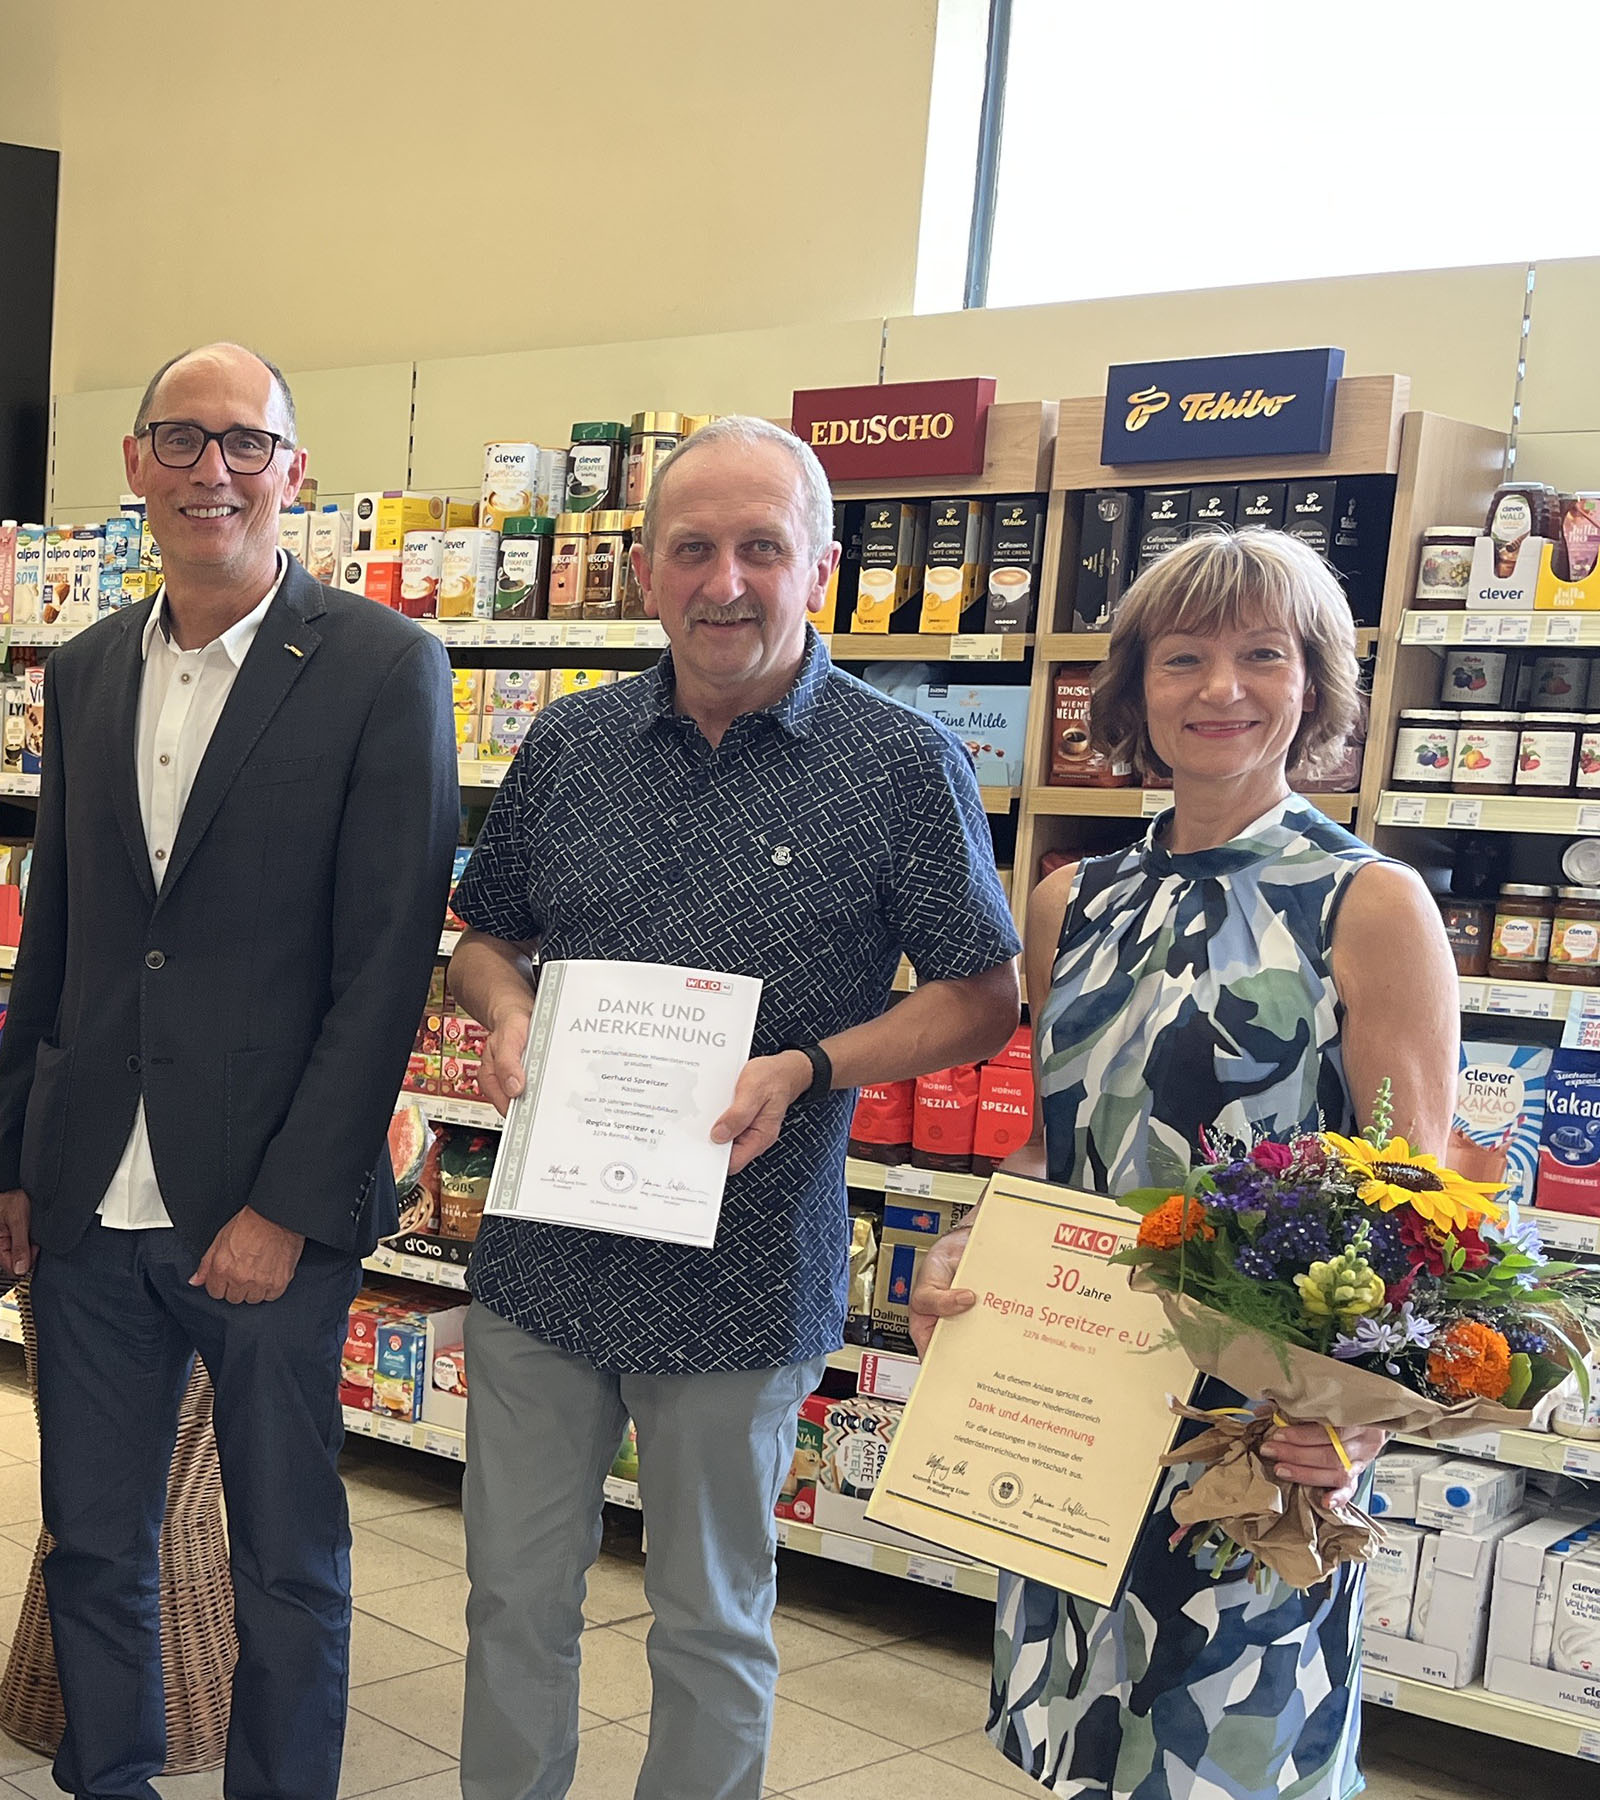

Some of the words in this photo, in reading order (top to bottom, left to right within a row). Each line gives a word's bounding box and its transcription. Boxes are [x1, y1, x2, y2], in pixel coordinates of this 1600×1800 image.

[1179, 390, 1297, 422] Tchibo
[810, 413, 954, 446] EDUSCHO
[495, 454, 525, 464] clever
[579, 456, 601, 464] clever
[1152, 510, 1178, 520] Tchibo
[1198, 508, 1225, 518] Tchibo
[1245, 506, 1273, 516] Tchibo
[1295, 502, 1324, 513] Tchibo
[936, 518, 960, 526] Tchibo
[1002, 518, 1027, 526] Tchibo
[1500, 512, 1526, 521] WALD
[870, 521, 893, 529] Tchibo
[17, 548, 40, 562] alpro
[47, 547, 70, 562] alpro
[73, 546, 96, 561] alpro
[508, 550, 529, 559] clever
[589, 563, 609, 571] GOLD
[16, 572, 38, 585] SOYA
[46, 573, 69, 583] MANDEL
[1479, 587, 1524, 600] clever
[10, 703, 25, 716] LY!
[932, 711, 965, 729] Feine
[968, 713, 1007, 729] Milde
[1506, 924, 1529, 932] clever
[1569, 928, 1593, 936] clever
[686, 978, 720, 991] WKO
[598, 998, 654, 1017] DANK
[662, 1003, 706, 1022] UND
[569, 1018, 727, 1048] ANERKENNUNG
[1008, 1050, 1032, 1059] SPEZIA
[602, 1074, 632, 1085] Gerhard
[634, 1077, 669, 1089] Spreitzer
[1465, 1069, 1515, 1085] clever
[981, 1100, 1028, 1116] SPEZIAL
[1458, 1094, 1516, 1115] KAKAO
[586, 1118, 612, 1130] Regina
[614, 1121, 648, 1134] Spreitzer
[1057, 1224, 1116, 1253] WKO
[405, 1238, 442, 1257] d'Oro
[1046, 1264, 1081, 1293] 30
[1077, 1286, 1112, 1303] Jahre
[873, 1308, 909, 1323] Dallma
[983, 1292, 1033, 1318] Regina
[1039, 1308, 1115, 1338] Spreitzer
[1118, 1330, 1152, 1349] e.U.
[436, 1360, 454, 1369] clever
[862, 1356, 875, 1393] AKTION
[993, 1370, 1006, 1381] Aus
[1006, 1374, 1032, 1387] diesem
[1056, 1388, 1081, 1401] spricht
[1082, 1394, 1094, 1405] die
[976, 1382, 1041, 1407] Wirtschaftskammer
[1042, 1400, 1101, 1424] Niederösterreich
[968, 1398, 996, 1417] Dank
[999, 1408, 1020, 1423] und
[1021, 1412, 1095, 1447] Anerkennung
[964, 1420, 975, 1431] für
[976, 1424, 988, 1435] die
[988, 1426, 1027, 1446] Leistungen
[1028, 1438, 1036, 1448] im
[1038, 1442, 1069, 1459] Interesse
[1070, 1452, 1084, 1463] der
[860, 1439, 874, 1483] KAFFEE
[953, 1434, 1030, 1464] niederösterreichischen
[1031, 1455, 1067, 1476] Wirtschaft
[1068, 1470, 1084, 1481] aus.
[1422, 1666, 1431, 1675] 12
